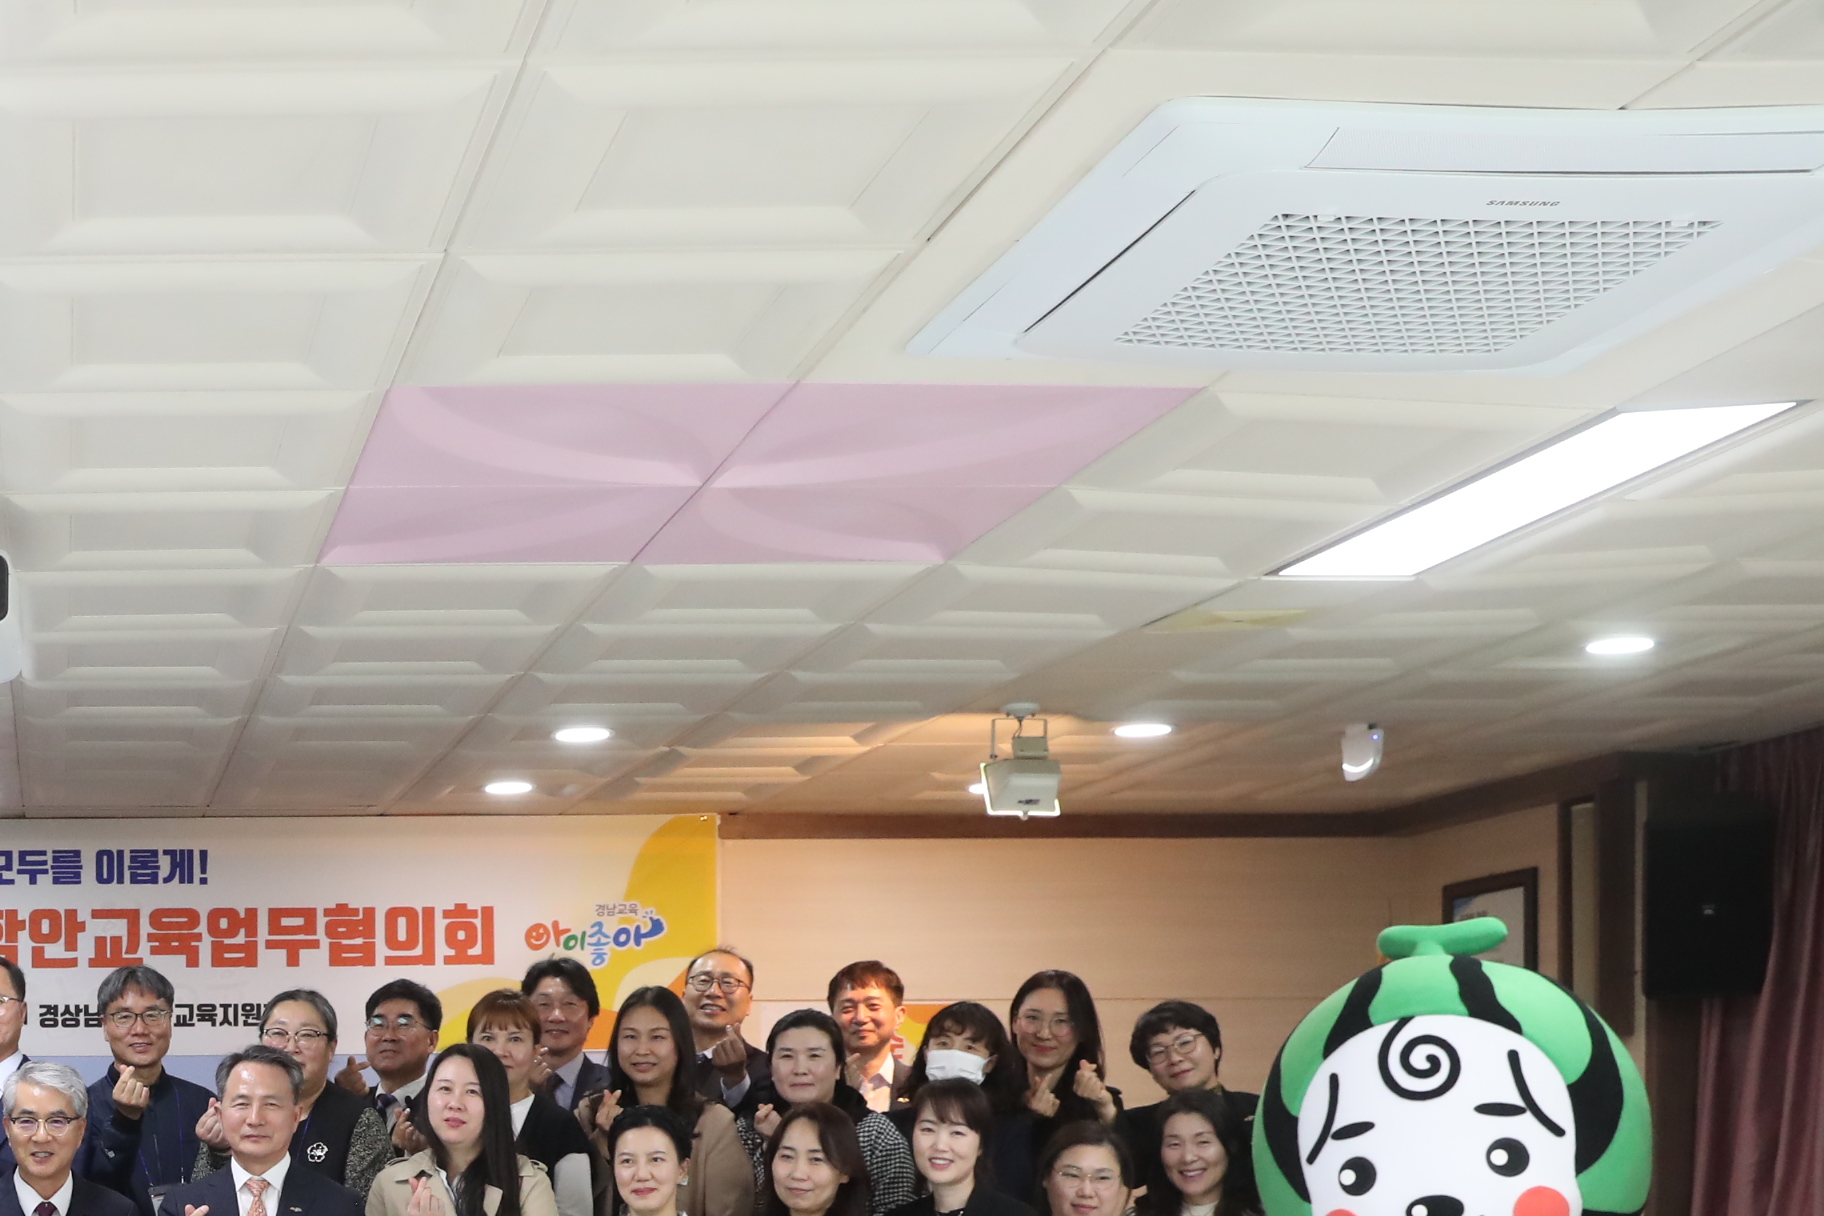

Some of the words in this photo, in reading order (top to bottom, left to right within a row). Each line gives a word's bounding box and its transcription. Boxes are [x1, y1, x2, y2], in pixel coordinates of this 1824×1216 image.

[1486, 199, 1561, 207] SAMSUNG
[95, 849, 209, 886] 이롭게!
[595, 903, 639, 917] 경남교육
[524, 916, 665, 966] 아이좋아
